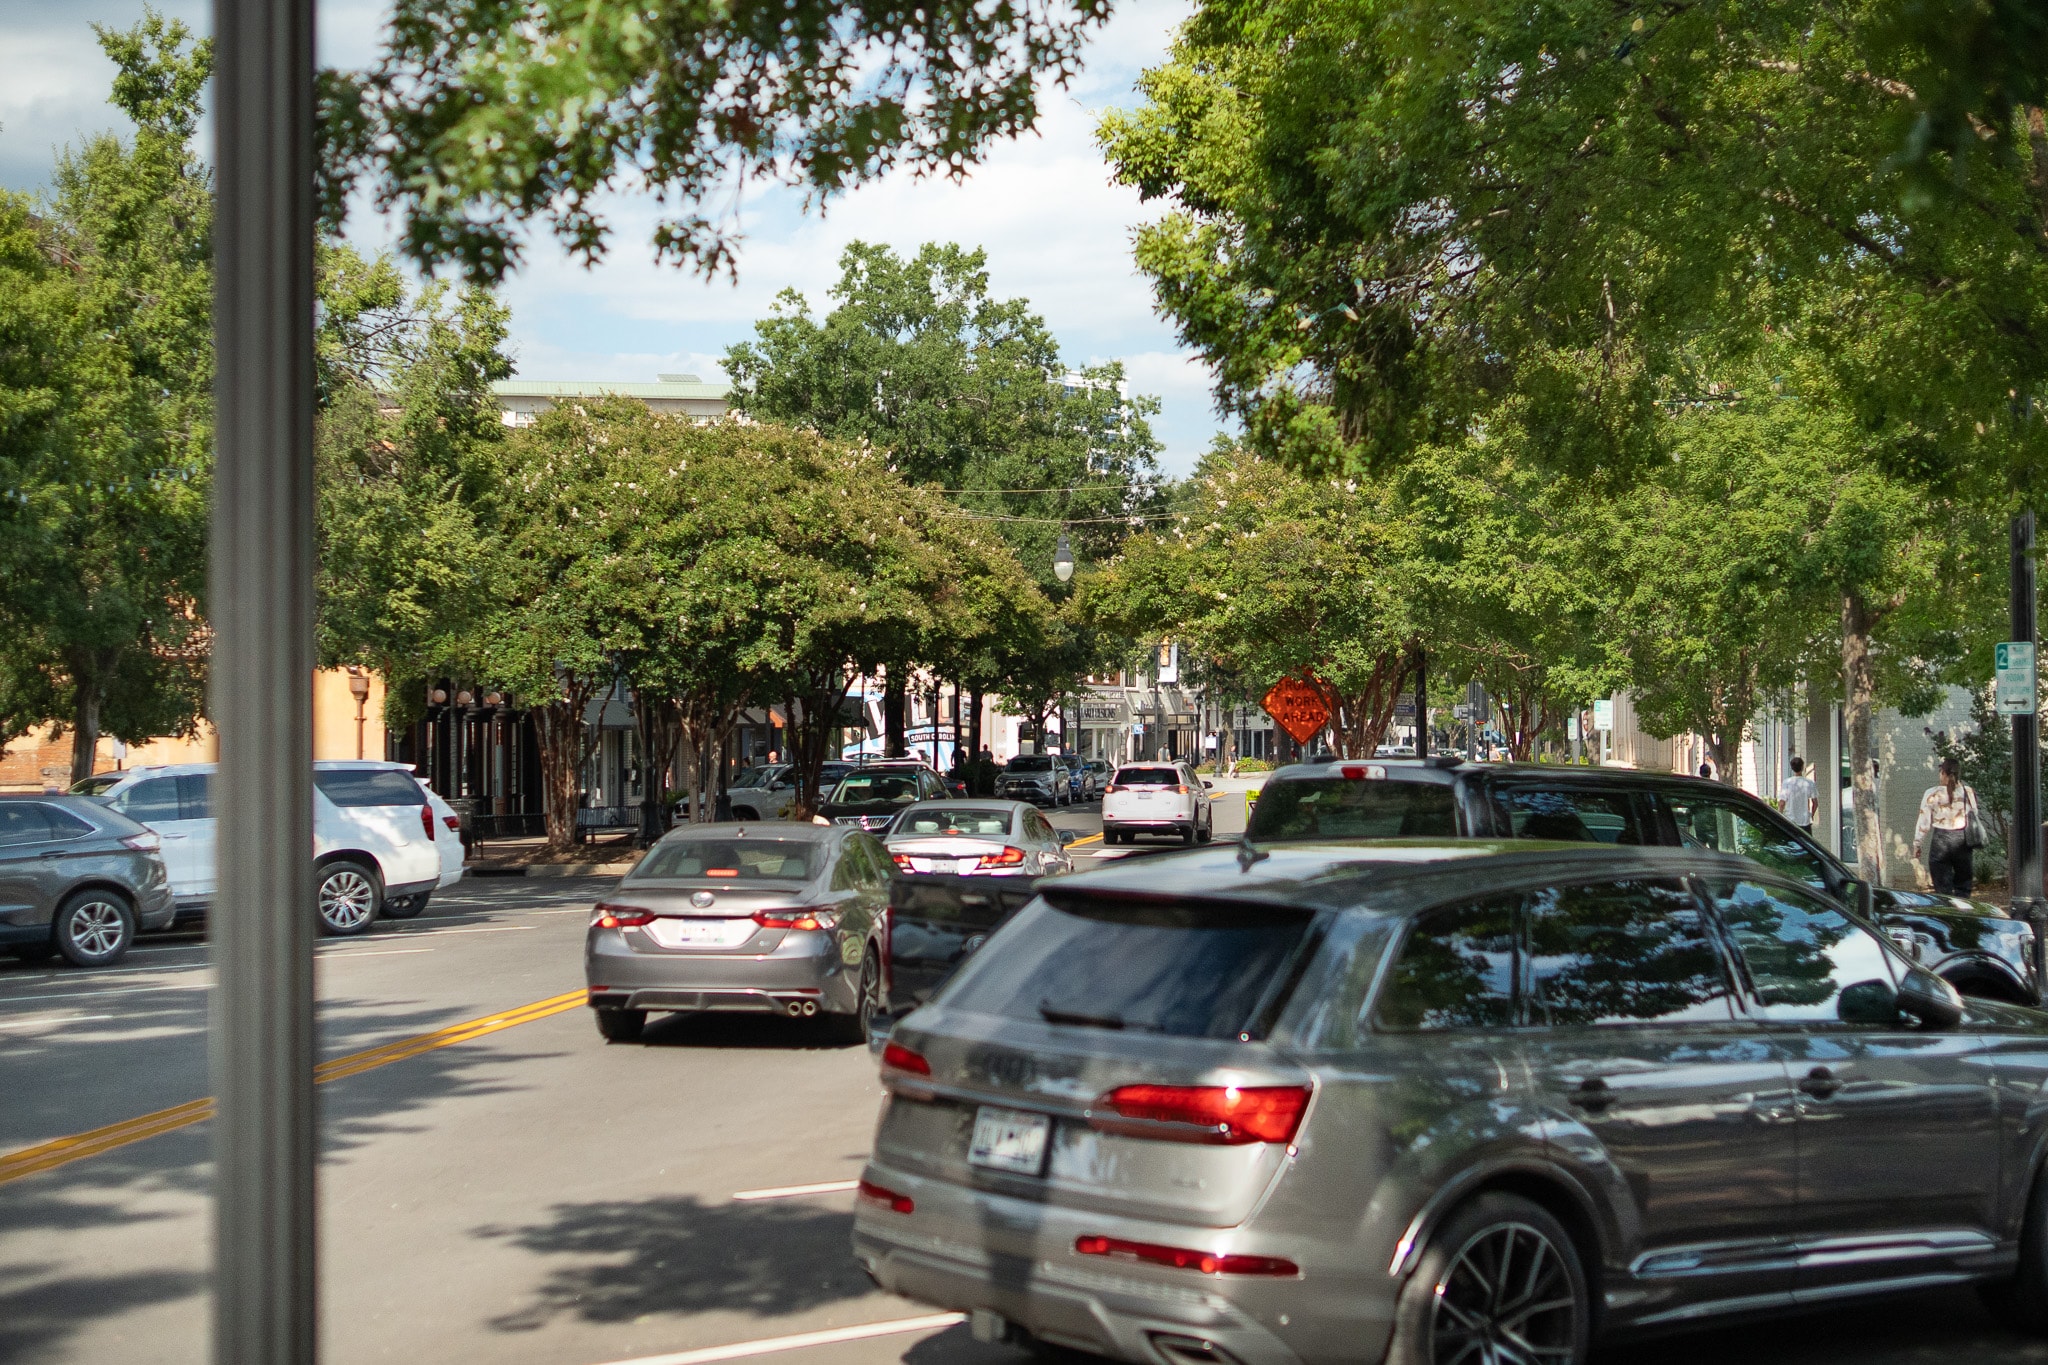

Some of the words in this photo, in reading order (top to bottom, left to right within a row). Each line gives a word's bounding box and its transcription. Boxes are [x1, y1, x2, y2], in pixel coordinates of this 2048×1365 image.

[1998, 648, 2008, 666] 2
[1285, 696, 1319, 706] WORK
[1282, 711, 1324, 722] AHEAD
[911, 733, 930, 742] SOUTH
